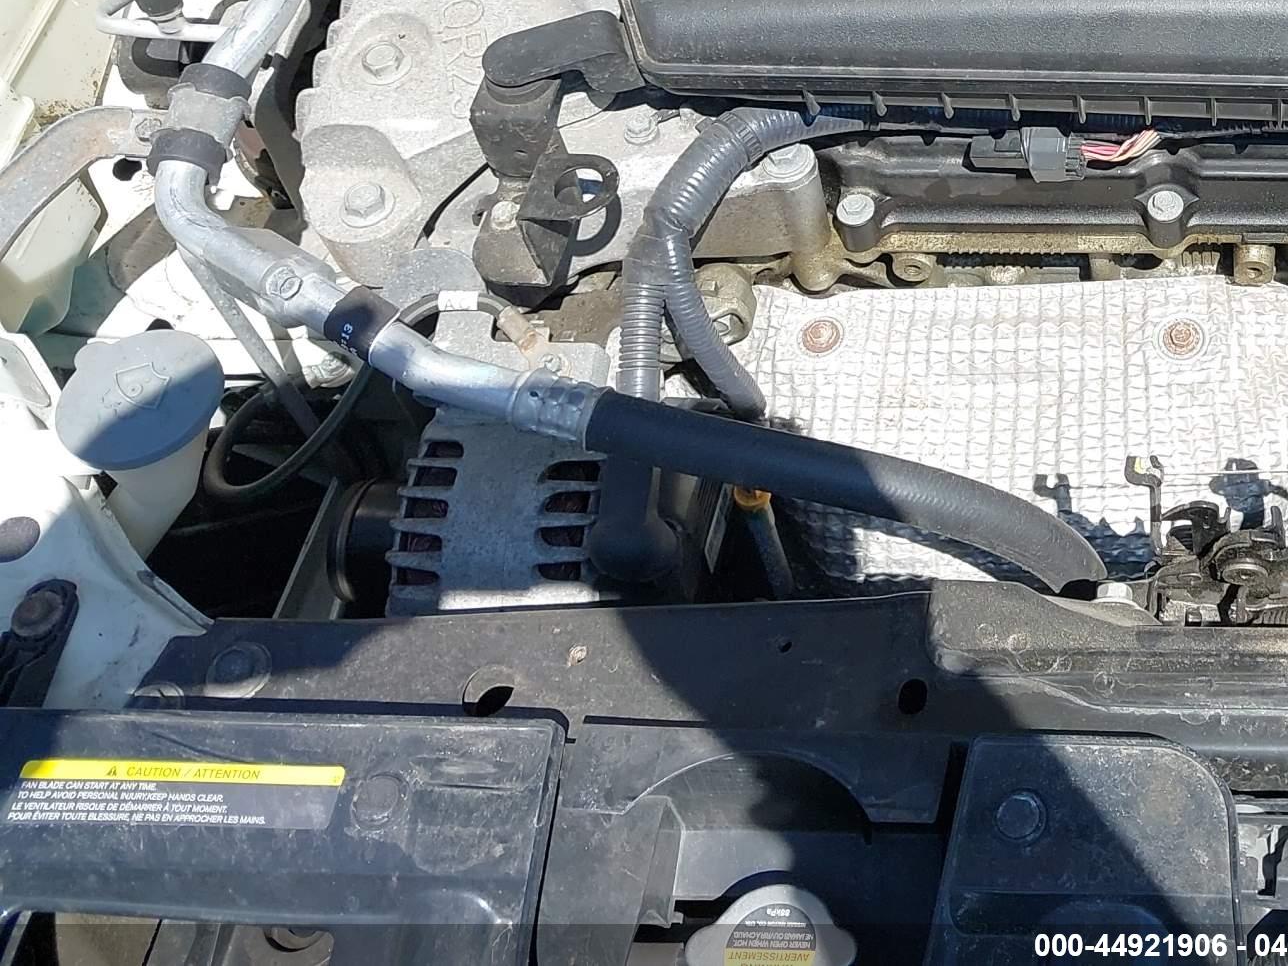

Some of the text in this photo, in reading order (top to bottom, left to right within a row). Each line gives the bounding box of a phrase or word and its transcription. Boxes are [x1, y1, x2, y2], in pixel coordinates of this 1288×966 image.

[126, 766, 180, 777] CAUTION
[193, 768, 261, 779] ATTENTION
[120, 801, 162, 811] DÉMARRER
[163, 802, 170, 812] À
[171, 804, 191, 812] TOUT
[32, 811, 61, 820] ÉVITER
[173, 815, 223, 823] APPROCHER
[728, 952, 810, 962] AVERTISSEMENT
